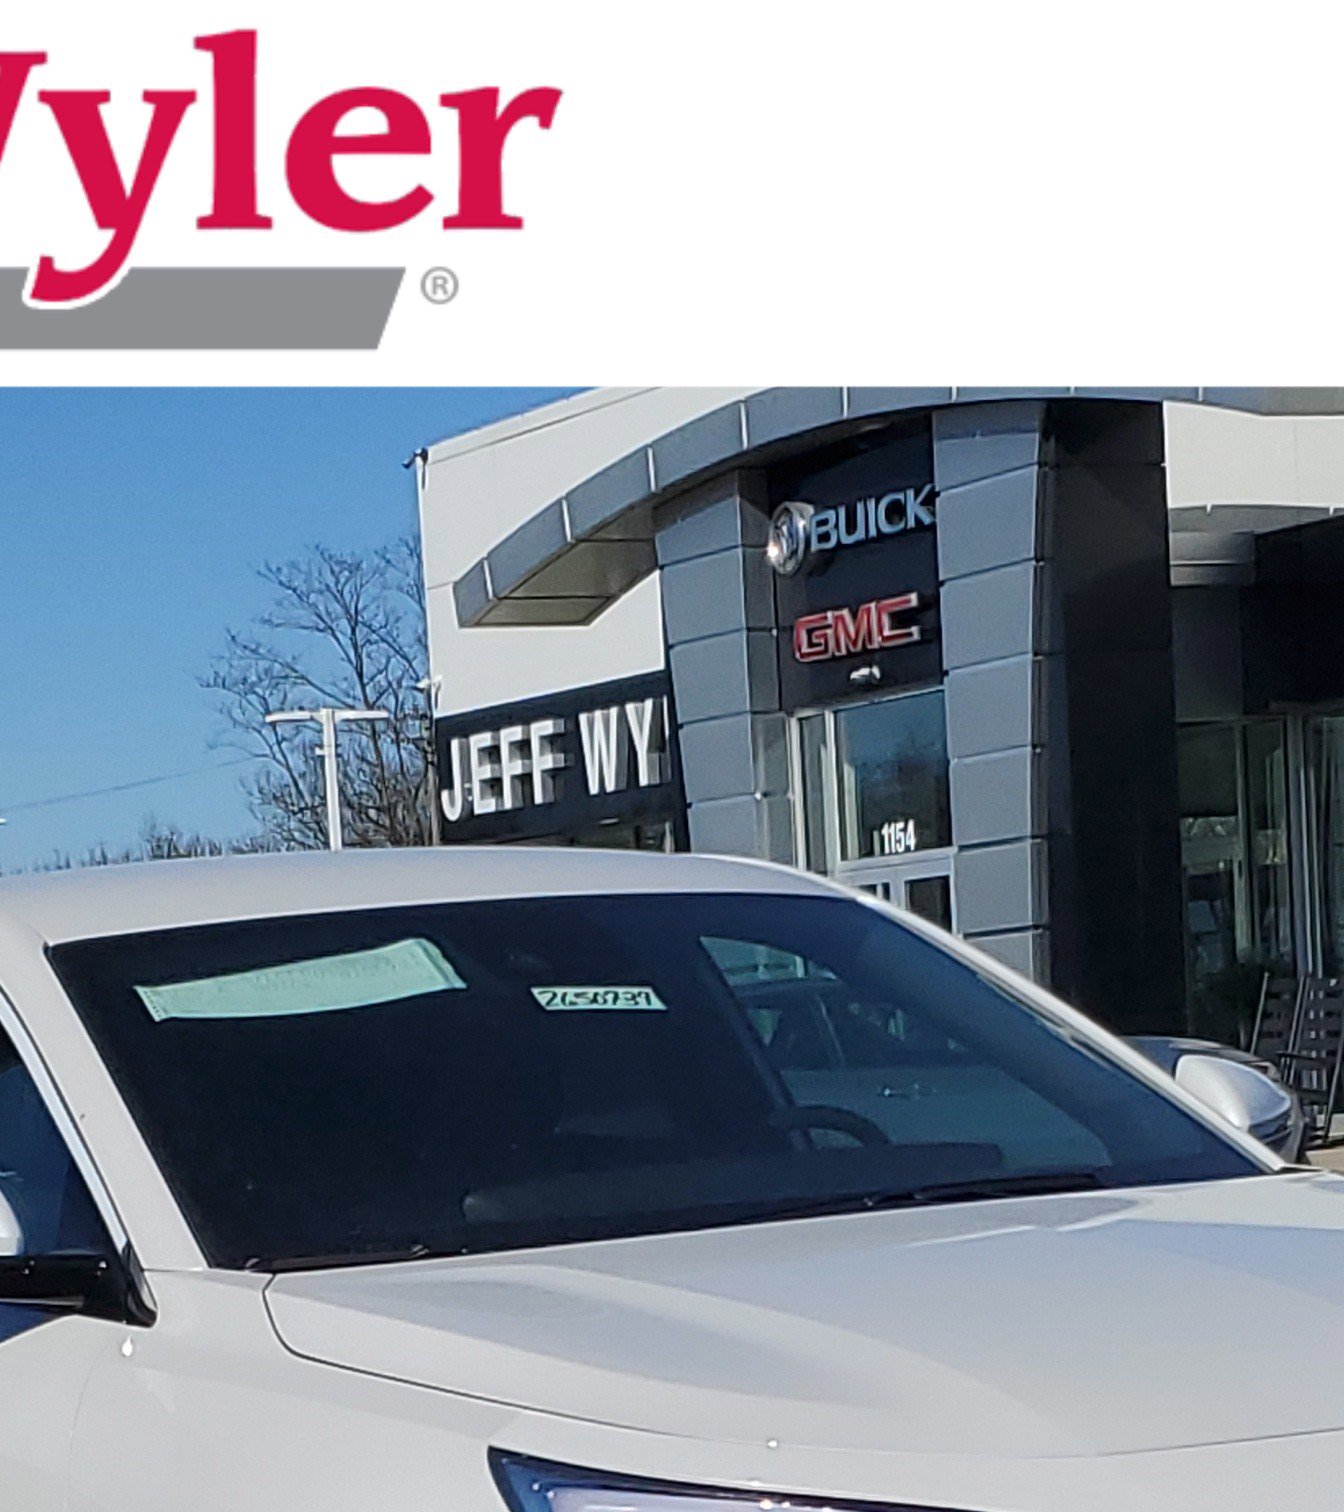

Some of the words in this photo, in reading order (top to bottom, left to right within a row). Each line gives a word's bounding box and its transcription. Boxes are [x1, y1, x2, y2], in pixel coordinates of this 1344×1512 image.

[809, 483, 937, 551] BUICK
[793, 592, 922, 663] GMC
[441, 718, 565, 822] JEFF
[880, 818, 917, 855] 1154
